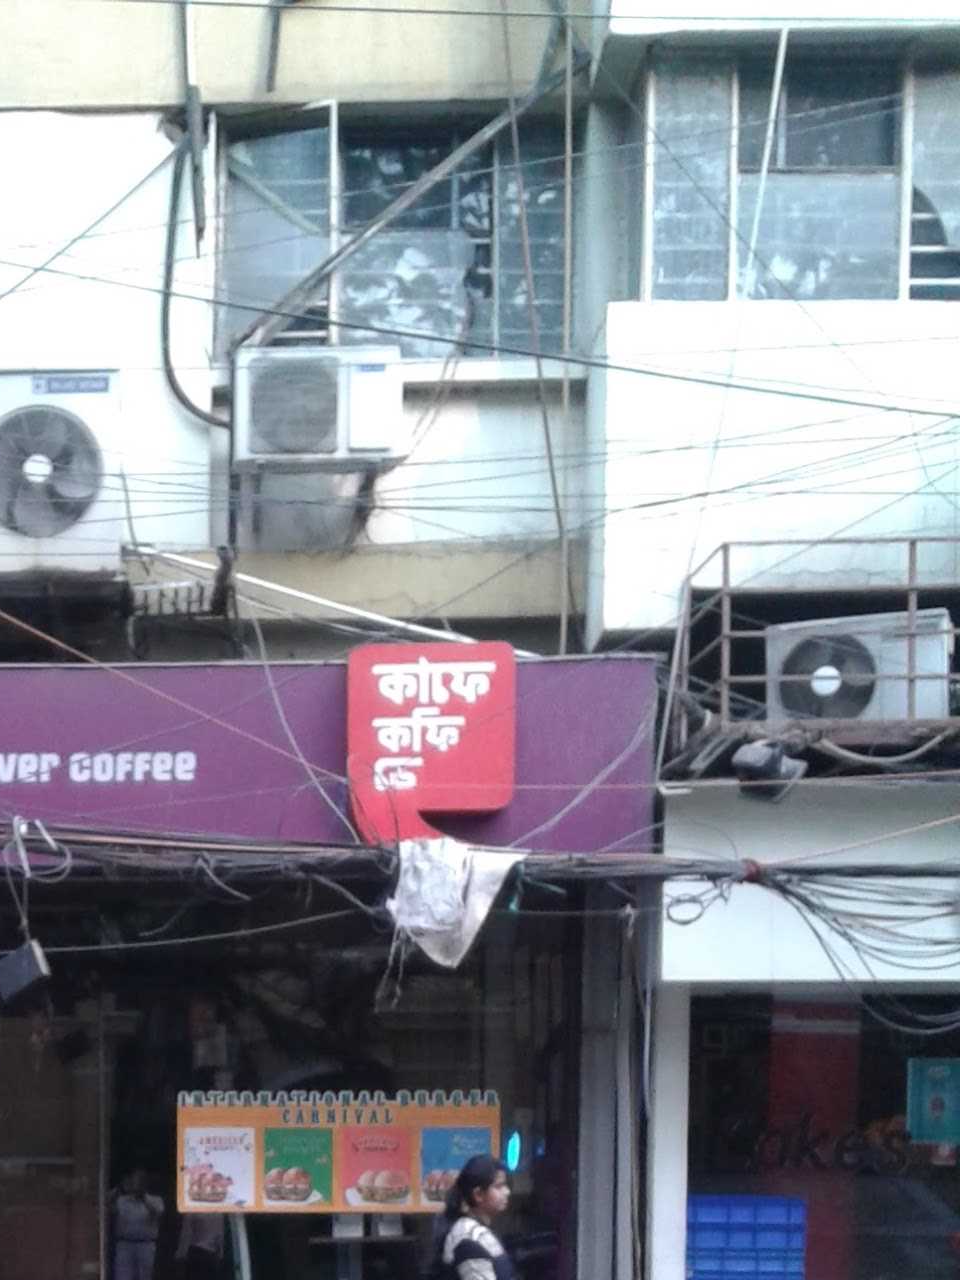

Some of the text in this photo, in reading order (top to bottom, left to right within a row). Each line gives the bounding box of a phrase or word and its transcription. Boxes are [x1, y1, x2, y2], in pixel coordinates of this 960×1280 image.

[371, 706, 466, 753] কফি
[69, 751, 197, 782] coffee
[178, 1088, 500, 1108] INTERNATIONAL BURGER
[281, 1108, 395, 1125] CARNIVAL
